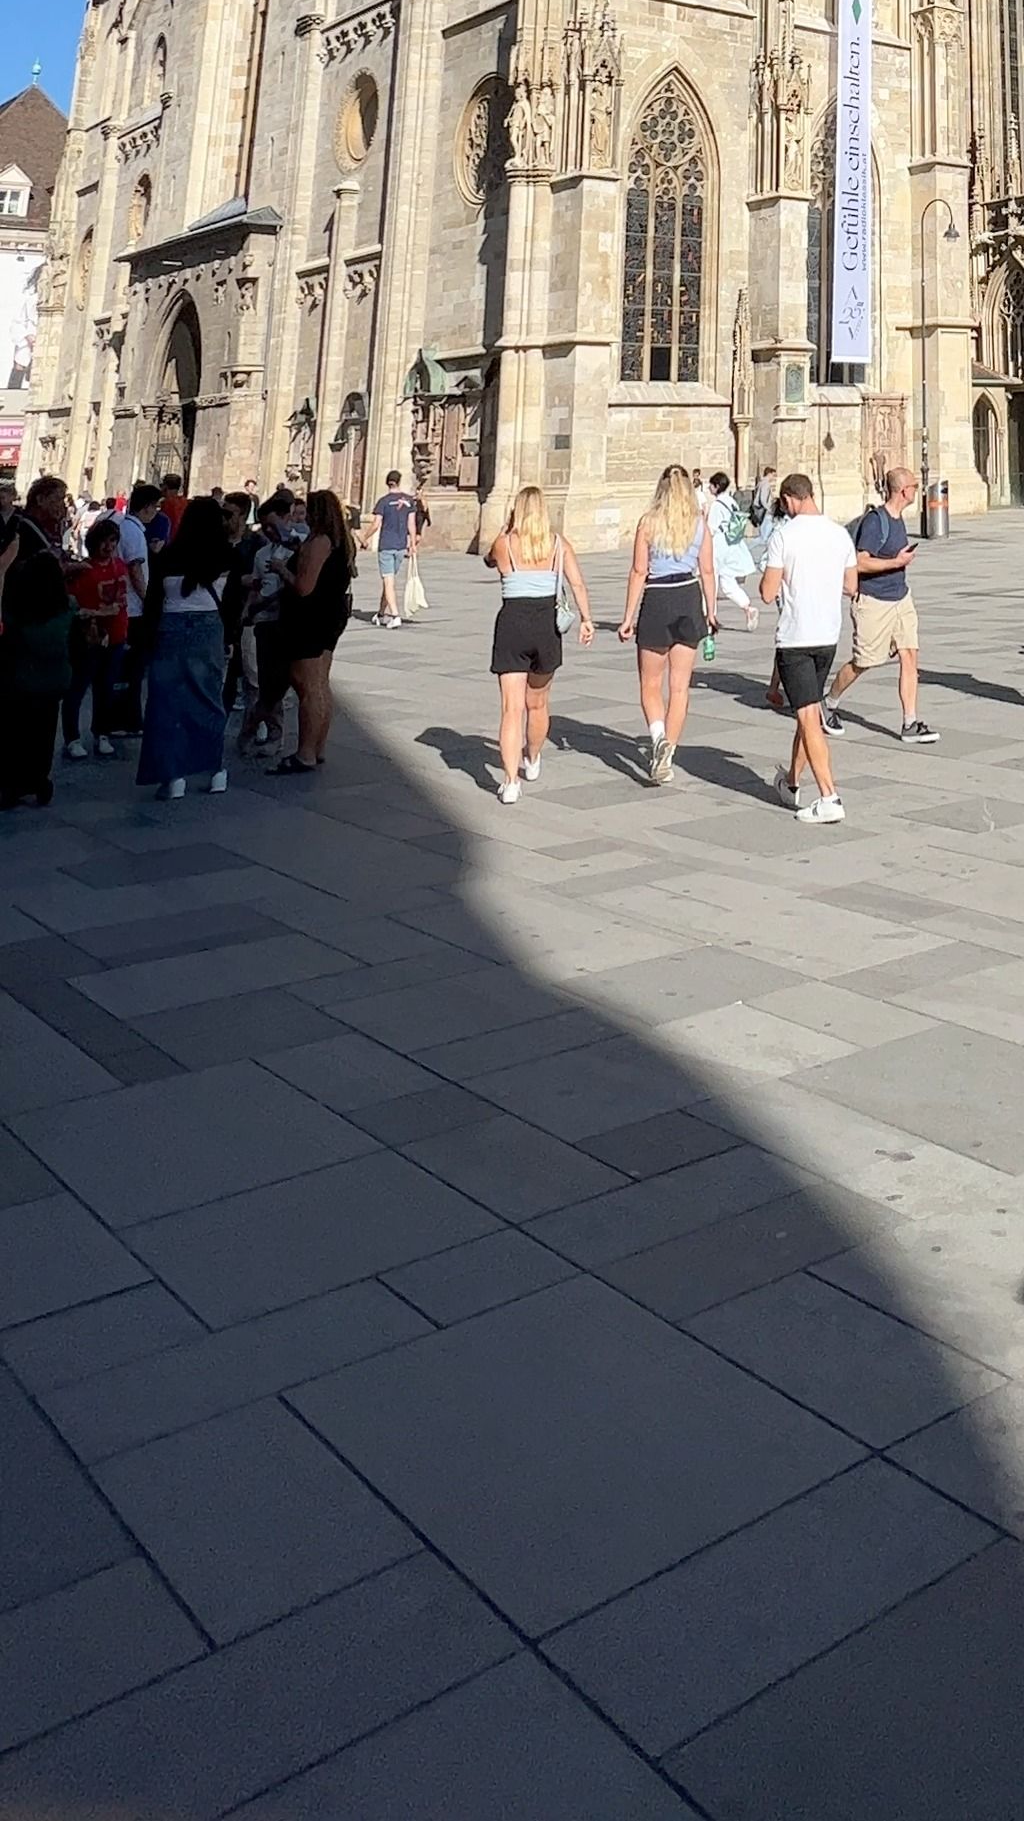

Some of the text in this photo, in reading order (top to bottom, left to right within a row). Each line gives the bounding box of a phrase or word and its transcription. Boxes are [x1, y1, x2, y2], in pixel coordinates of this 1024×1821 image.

[841, 37, 860, 271] Gefühle einschalten.
[860, 153, 868, 272] www.radioklassik.at
